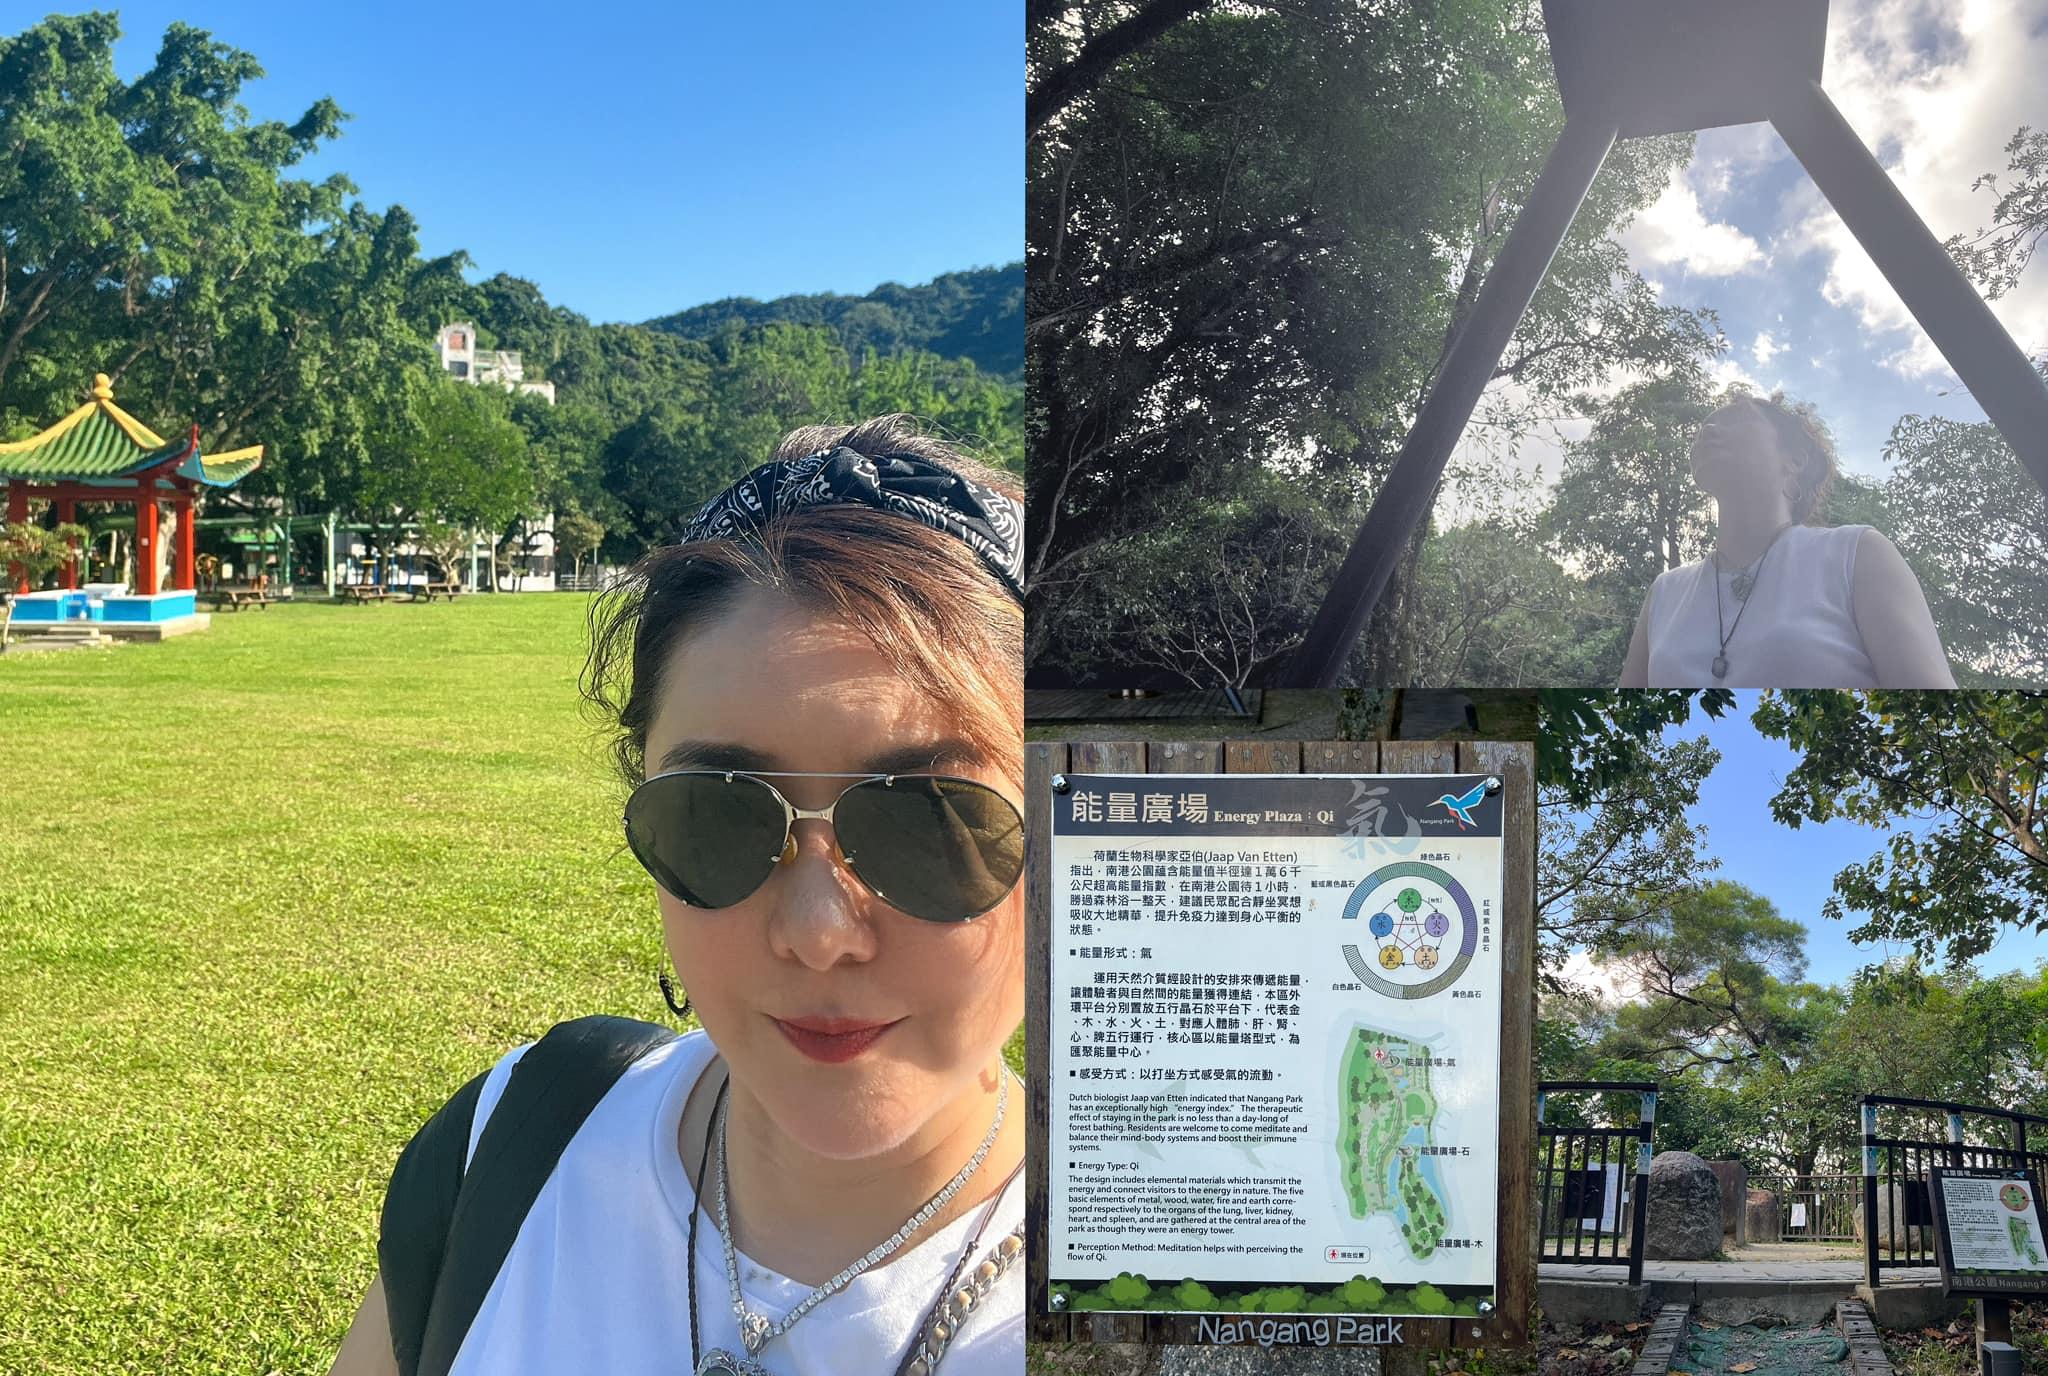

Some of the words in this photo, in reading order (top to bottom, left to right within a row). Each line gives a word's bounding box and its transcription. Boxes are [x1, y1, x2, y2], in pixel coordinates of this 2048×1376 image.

[1071, 790, 1208, 824] 能量廣場
[1214, 810, 1262, 825] Energy
[1264, 810, 1302, 822] Plaza
[1317, 810, 1334, 824] Qi
[1237, 851, 1260, 862] Van
[1263, 851, 1298, 865] Etten)
[1433, 919, 1441, 930] 火
[1385, 951, 1396, 963] 金
[1094, 1094, 1129, 1103] biologist
[1130, 1094, 1149, 1103] Jaap
[1167, 1094, 1188, 1102] Etten
[1190, 1094, 1227, 1102] indicated
[1229, 1094, 1245, 1102] that
[1247, 1095, 1284, 1104] Nangang
[1095, 1104, 1149, 1113] exceptionally
[1150, 1104, 1168, 1113] high
[1175, 1104, 1206, 1114] “energy
[1207, 1104, 1234, 1112] index.”
[1240, 1104, 1255, 1112] The
[1258, 1105, 1303, 1114] therapeutic
[1103, 1114, 1131, 1123] staying
[1158, 1114, 1176, 1124] park
[1199, 1114, 1214, 1122] less
[1216, 1114, 1234, 1122] than
[1242, 1115, 1279, 1124] day-long
[1093, 1124, 1126, 1133] bathing.
[1183, 1124, 1219, 1132] welcome
[1121, 1134, 1166, 1144] mind-body
[1168, 1135, 1199, 1144] systems
[1201, 1134, 1217, 1142] and
[1069, 1144, 1101, 1153] systems.
[1079, 1162, 1105, 1171] Energy
[1107, 1162, 1128, 1171] Type:
[1130, 1162, 1139, 1170] Qi
[1085, 1176, 1110, 1185] design
[1112, 1176, 1146, 1184] includes
[1147, 1176, 1187, 1184] elemental
[1288, 1177, 1302, 1185] the
[1069, 1187, 1095, 1195] energy
[1187, 1186, 1202, 1194] the
[1203, 1188, 1231, 1196] energy
[1069, 1195, 1088, 1203] basic
[1138, 1196, 1162, 1204] metal,
[1164, 1196, 1189, 1204] wood,
[1191, 1197, 1215, 1205] water,
[1217, 1196, 1230, 1204] fire
[1069, 1205, 1092, 1215] spond
[1094, 1206, 1142, 1215] respectively
[1168, 1208, 1196, 1216] organs
[1198, 1206, 1207, 1214] of
[1208, 1206, 1221, 1214] the
[1223, 1207, 1243, 1216] lung,
[1245, 1207, 1264, 1215] liver,
[1266, 1207, 1294, 1217] kidney,
[1069, 1215, 1091, 1223] heart,
[1091, 1215, 1107, 1223] and
[1109, 1215, 1137, 1225] spleen,
[1171, 1216, 1207, 1226] gathered
[1219, 1216, 1232, 1224] the
[1282, 1217, 1291, 1225] of
[1293, 1217, 1306, 1225] the
[1068, 1225, 1085, 1234] park
[1097, 1225, 1126, 1235] though
[1128, 1226, 1146, 1235] they
[1181, 1228, 1208, 1236] energy
[1078, 1243, 1120, 1253] Perception
[1158, 1244, 1202, 1252] Meditation
[1204, 1245, 1225, 1254] helps
[1246, 1245, 1288, 1255] perceiving
[1290, 1245, 1303, 1253] the
[1096, 1253, 1107, 1262] Qi.
[1197, 1316, 1330, 1347] Nangang
[1336, 1316, 1404, 1345] Park
